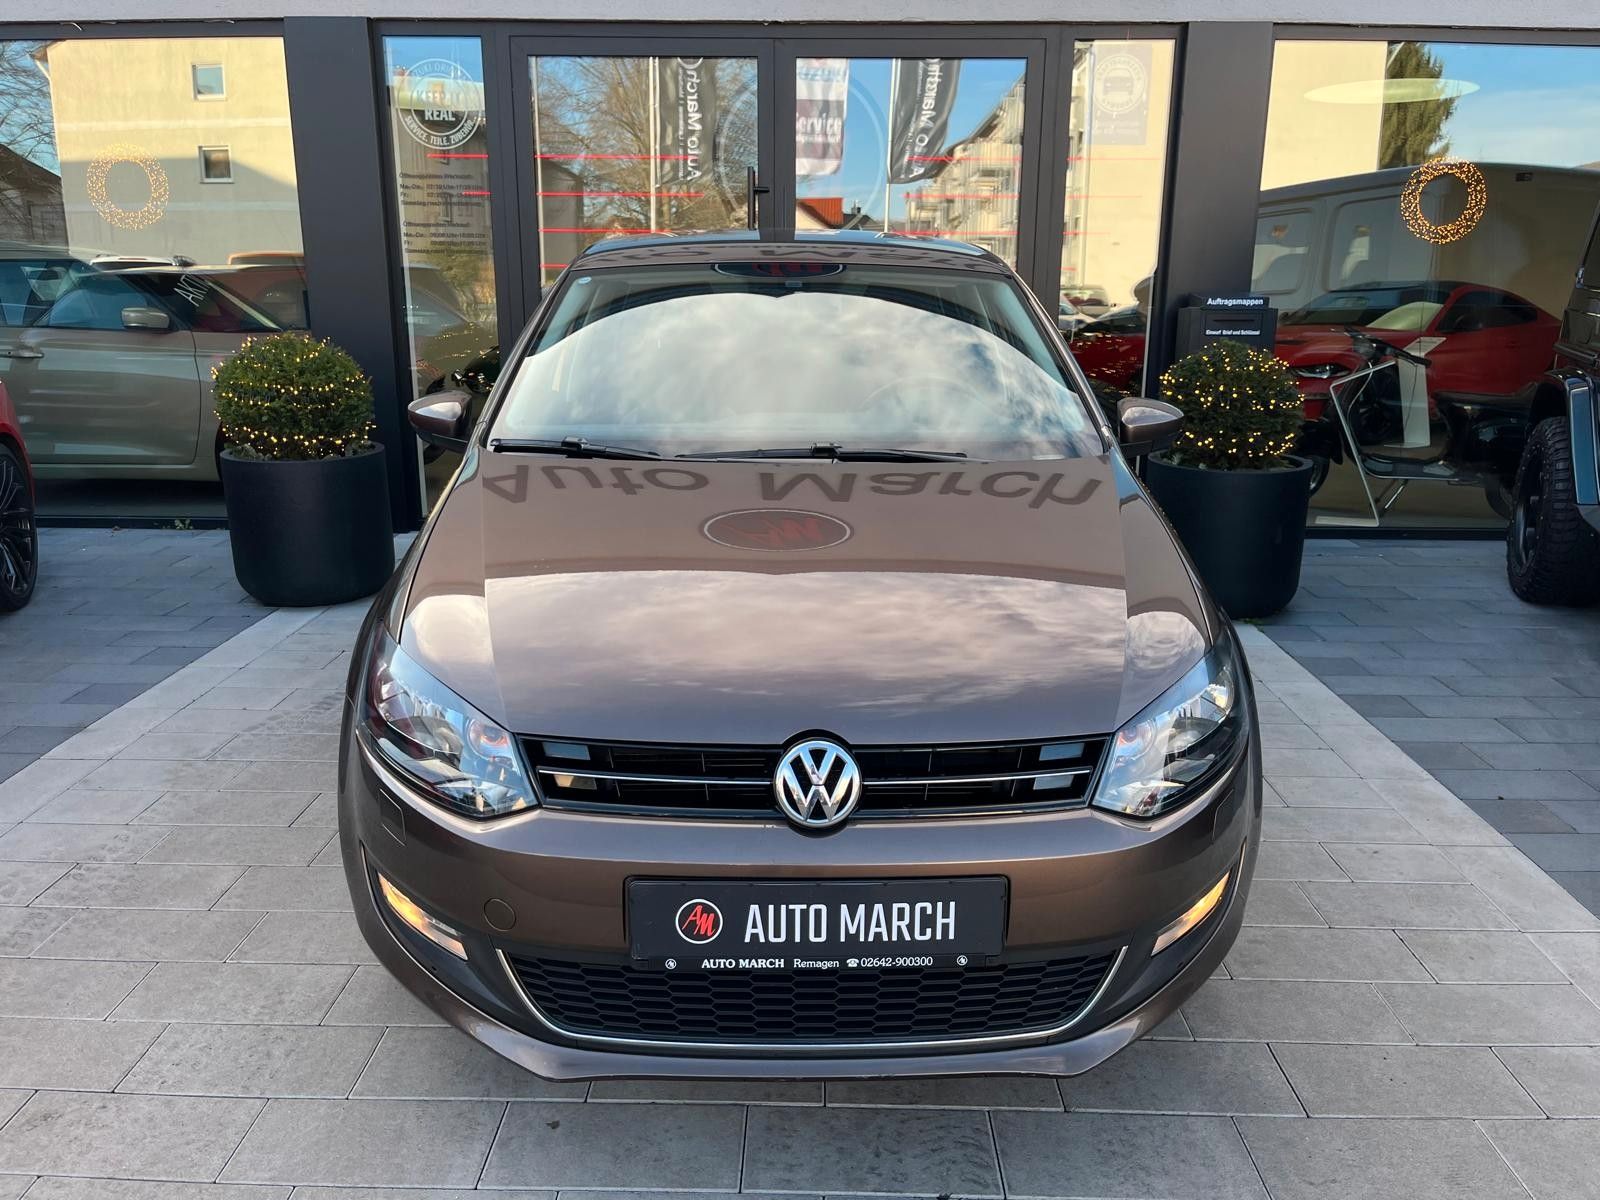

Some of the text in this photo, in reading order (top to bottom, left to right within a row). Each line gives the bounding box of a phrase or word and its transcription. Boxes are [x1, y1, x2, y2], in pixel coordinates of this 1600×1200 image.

[424, 106, 456, 121] REAL
[1206, 297, 1264, 307] Auftragsmappen
[744, 904, 827, 943] AUTO
[840, 901, 956, 943] MARCH
[702, 959, 736, 969] AUTO
[739, 959, 785, 969] MARCH
[793, 958, 840, 970] Remagen
[860, 956, 933, 967] 02642-900300
